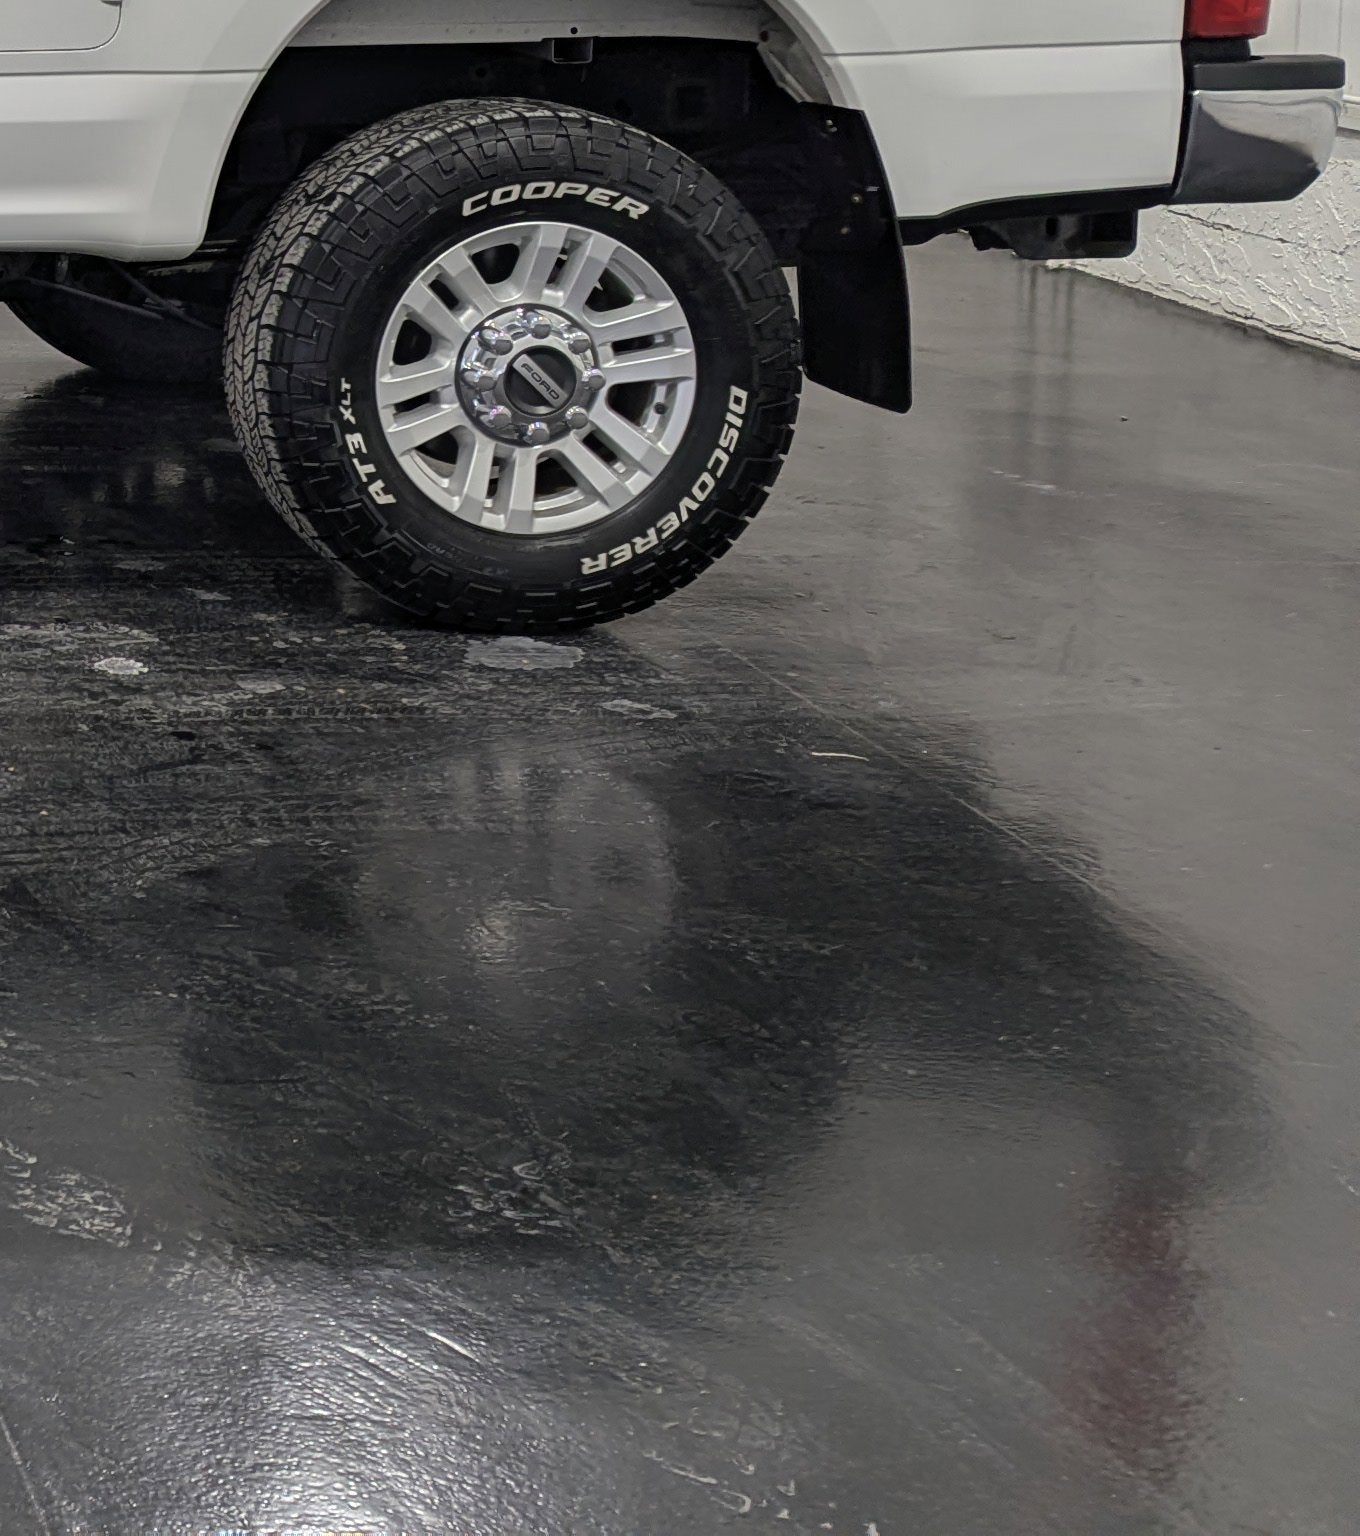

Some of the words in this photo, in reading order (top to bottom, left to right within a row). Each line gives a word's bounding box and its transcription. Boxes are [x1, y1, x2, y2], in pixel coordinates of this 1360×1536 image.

[461, 180, 650, 221] COOPER
[338, 377, 357, 425] XLT
[520, 362, 560, 401] FORD
[344, 431, 398, 506] AT3
[580, 384, 749, 576] DISCOVERER
